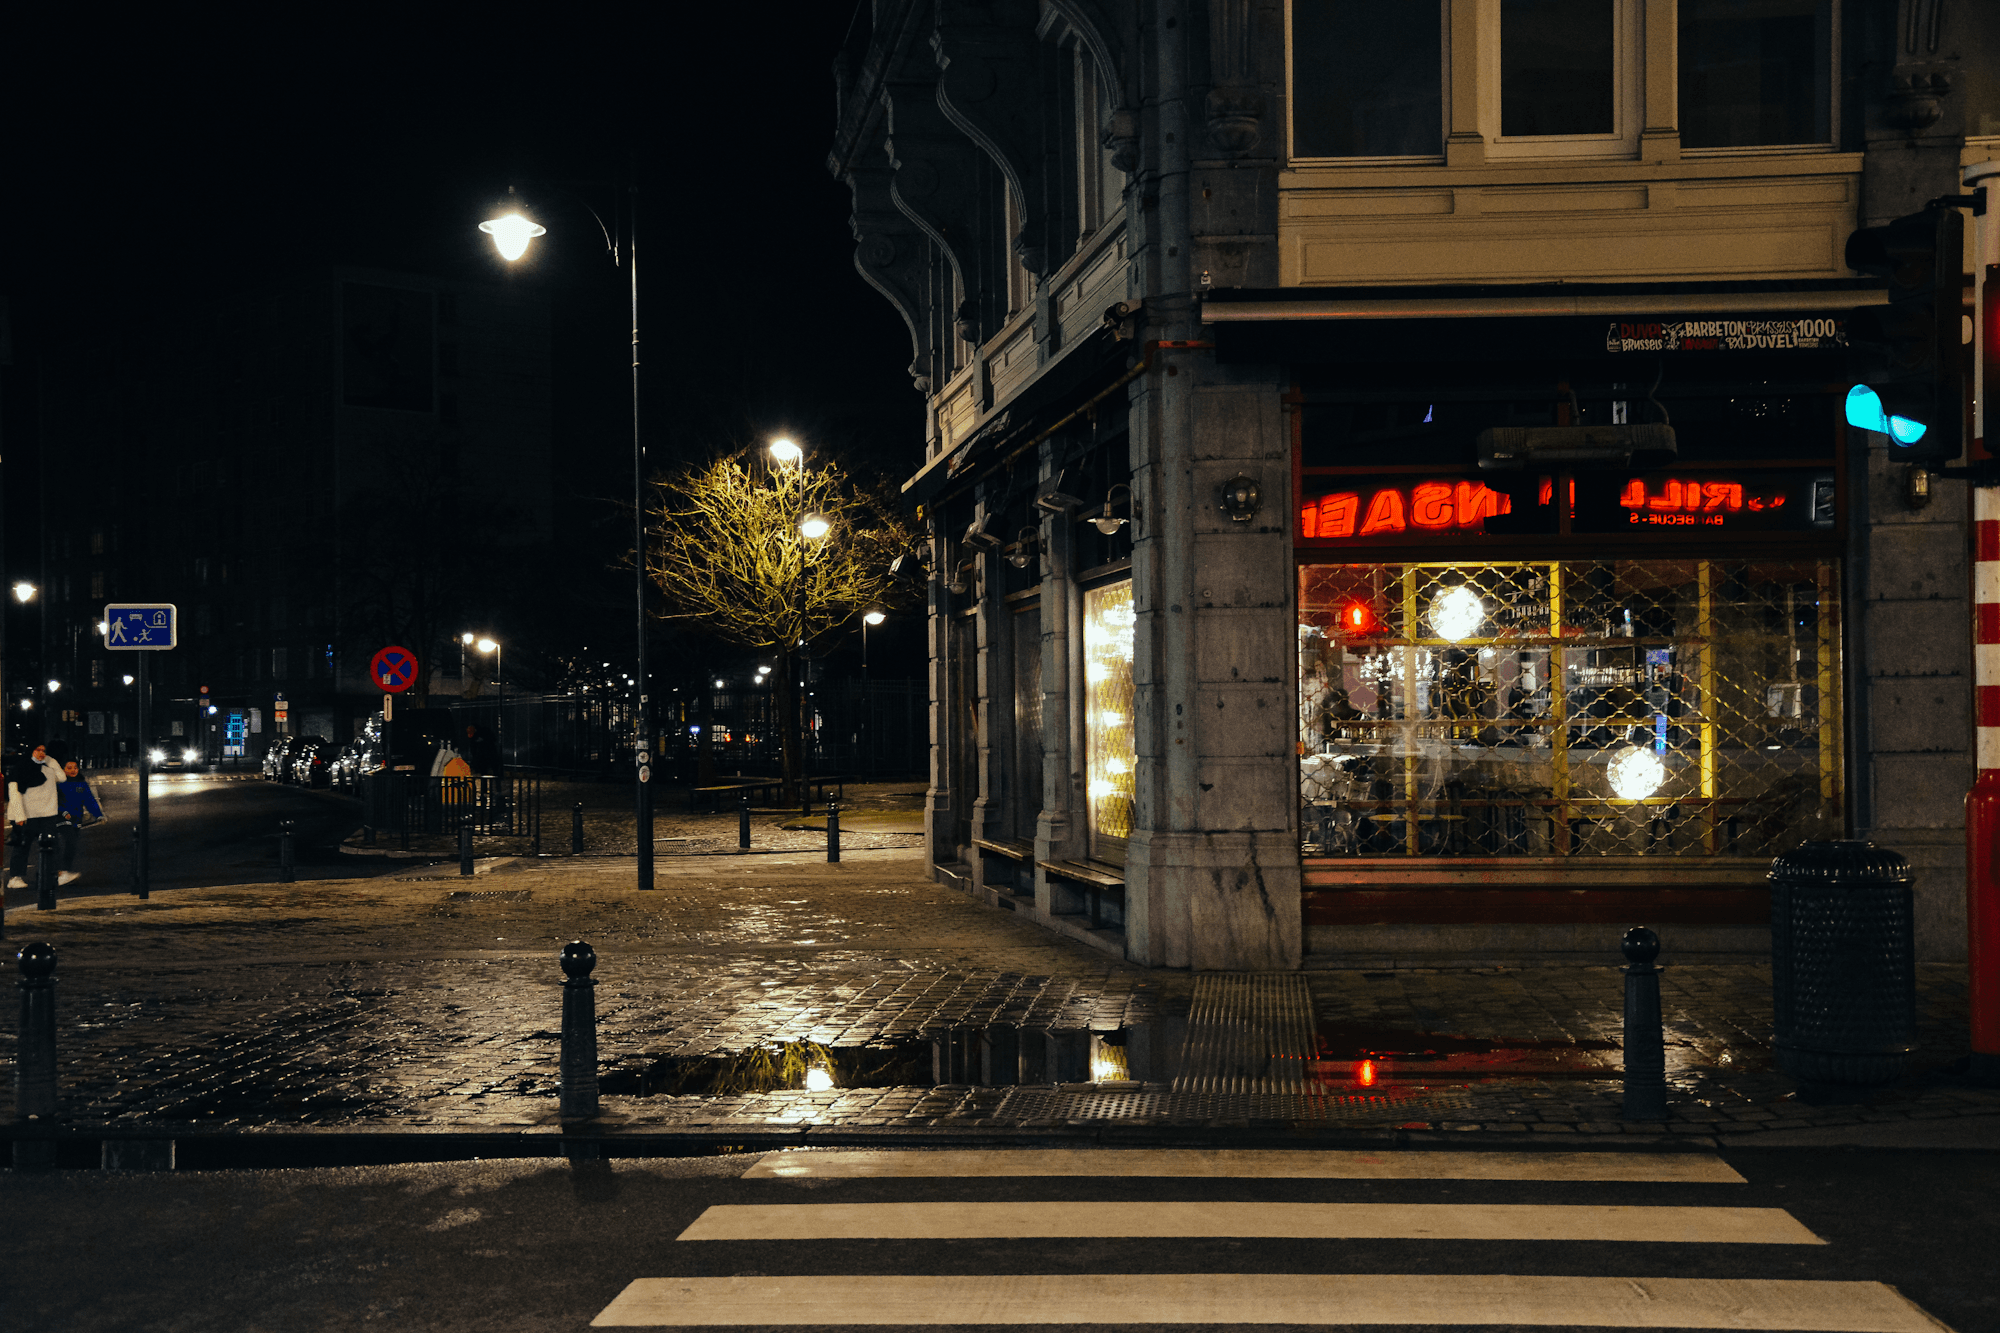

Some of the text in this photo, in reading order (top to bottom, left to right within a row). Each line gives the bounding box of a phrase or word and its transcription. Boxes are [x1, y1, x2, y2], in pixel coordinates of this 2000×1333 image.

[1684, 320, 1747, 338] BARBETON
[1797, 319, 1836, 338] 1000
[1744, 334, 1794, 350] DUVEL
